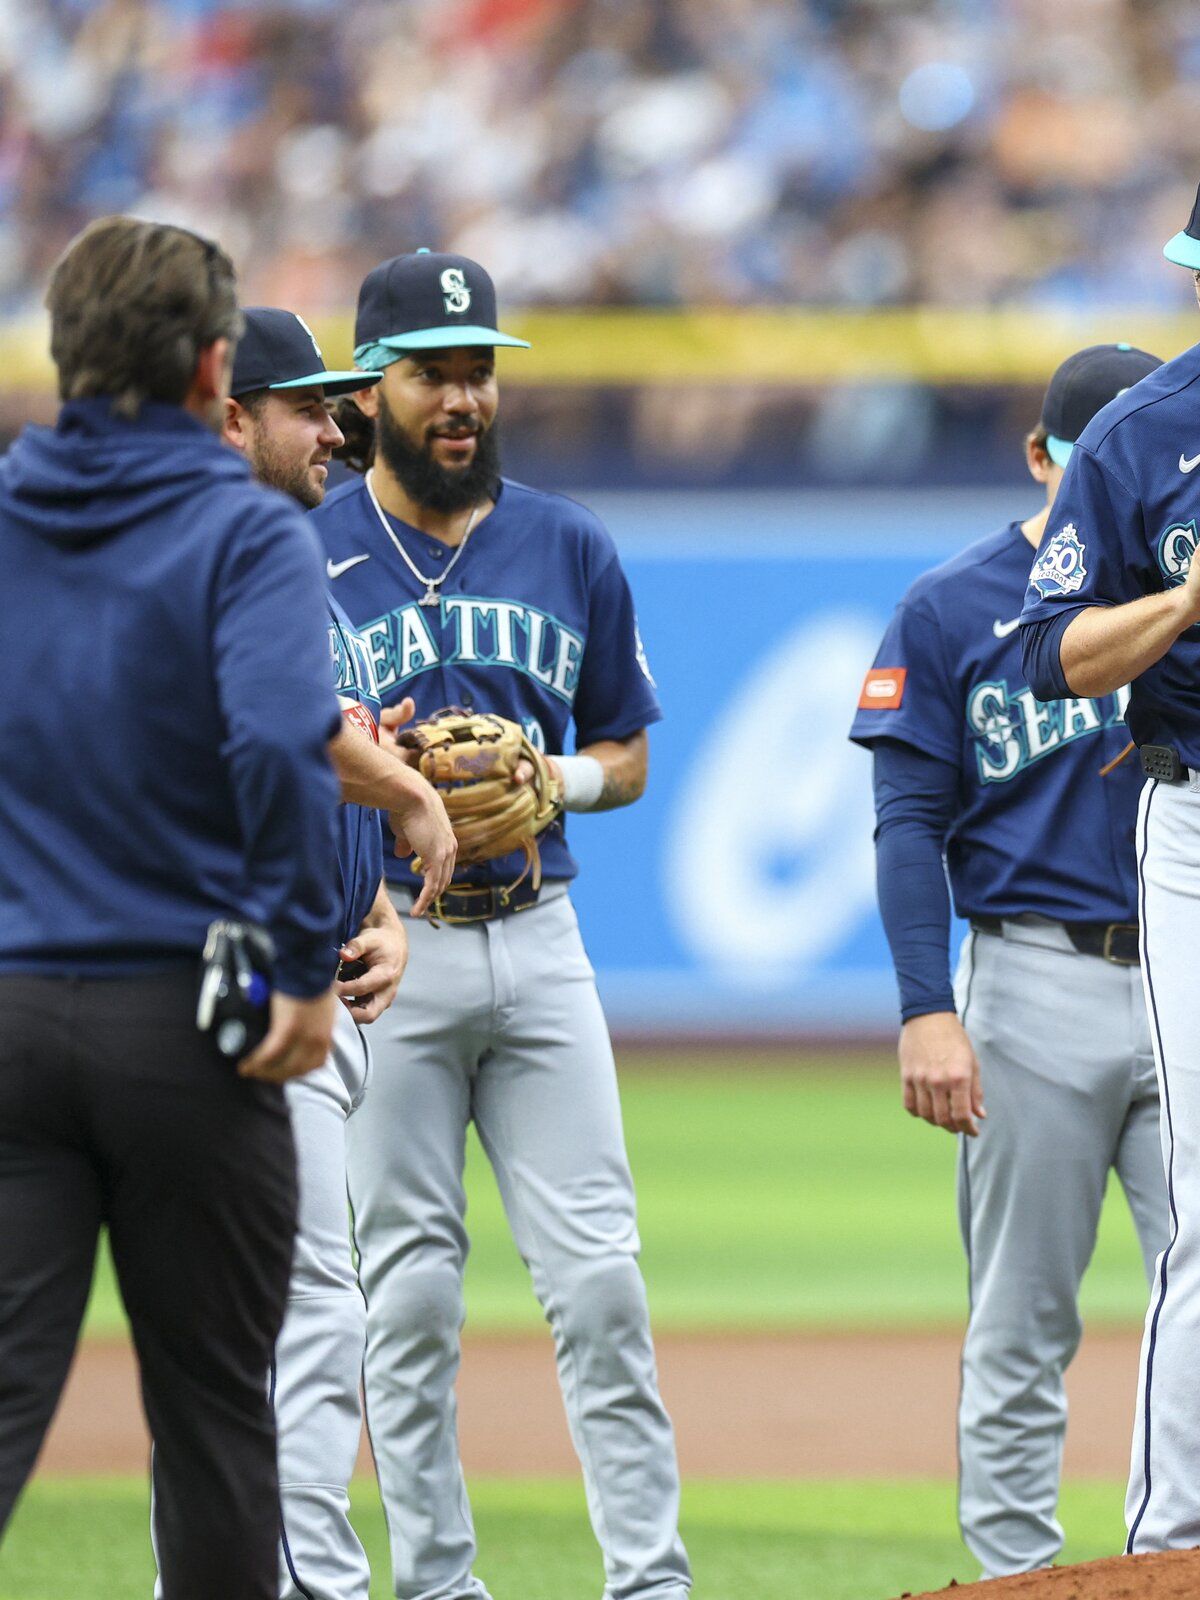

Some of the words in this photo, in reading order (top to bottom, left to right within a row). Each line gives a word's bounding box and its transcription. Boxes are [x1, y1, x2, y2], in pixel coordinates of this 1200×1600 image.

[440, 268, 472, 315] S
[1042, 543, 1077, 576] 50
[358, 595, 586, 705] EATTLE
